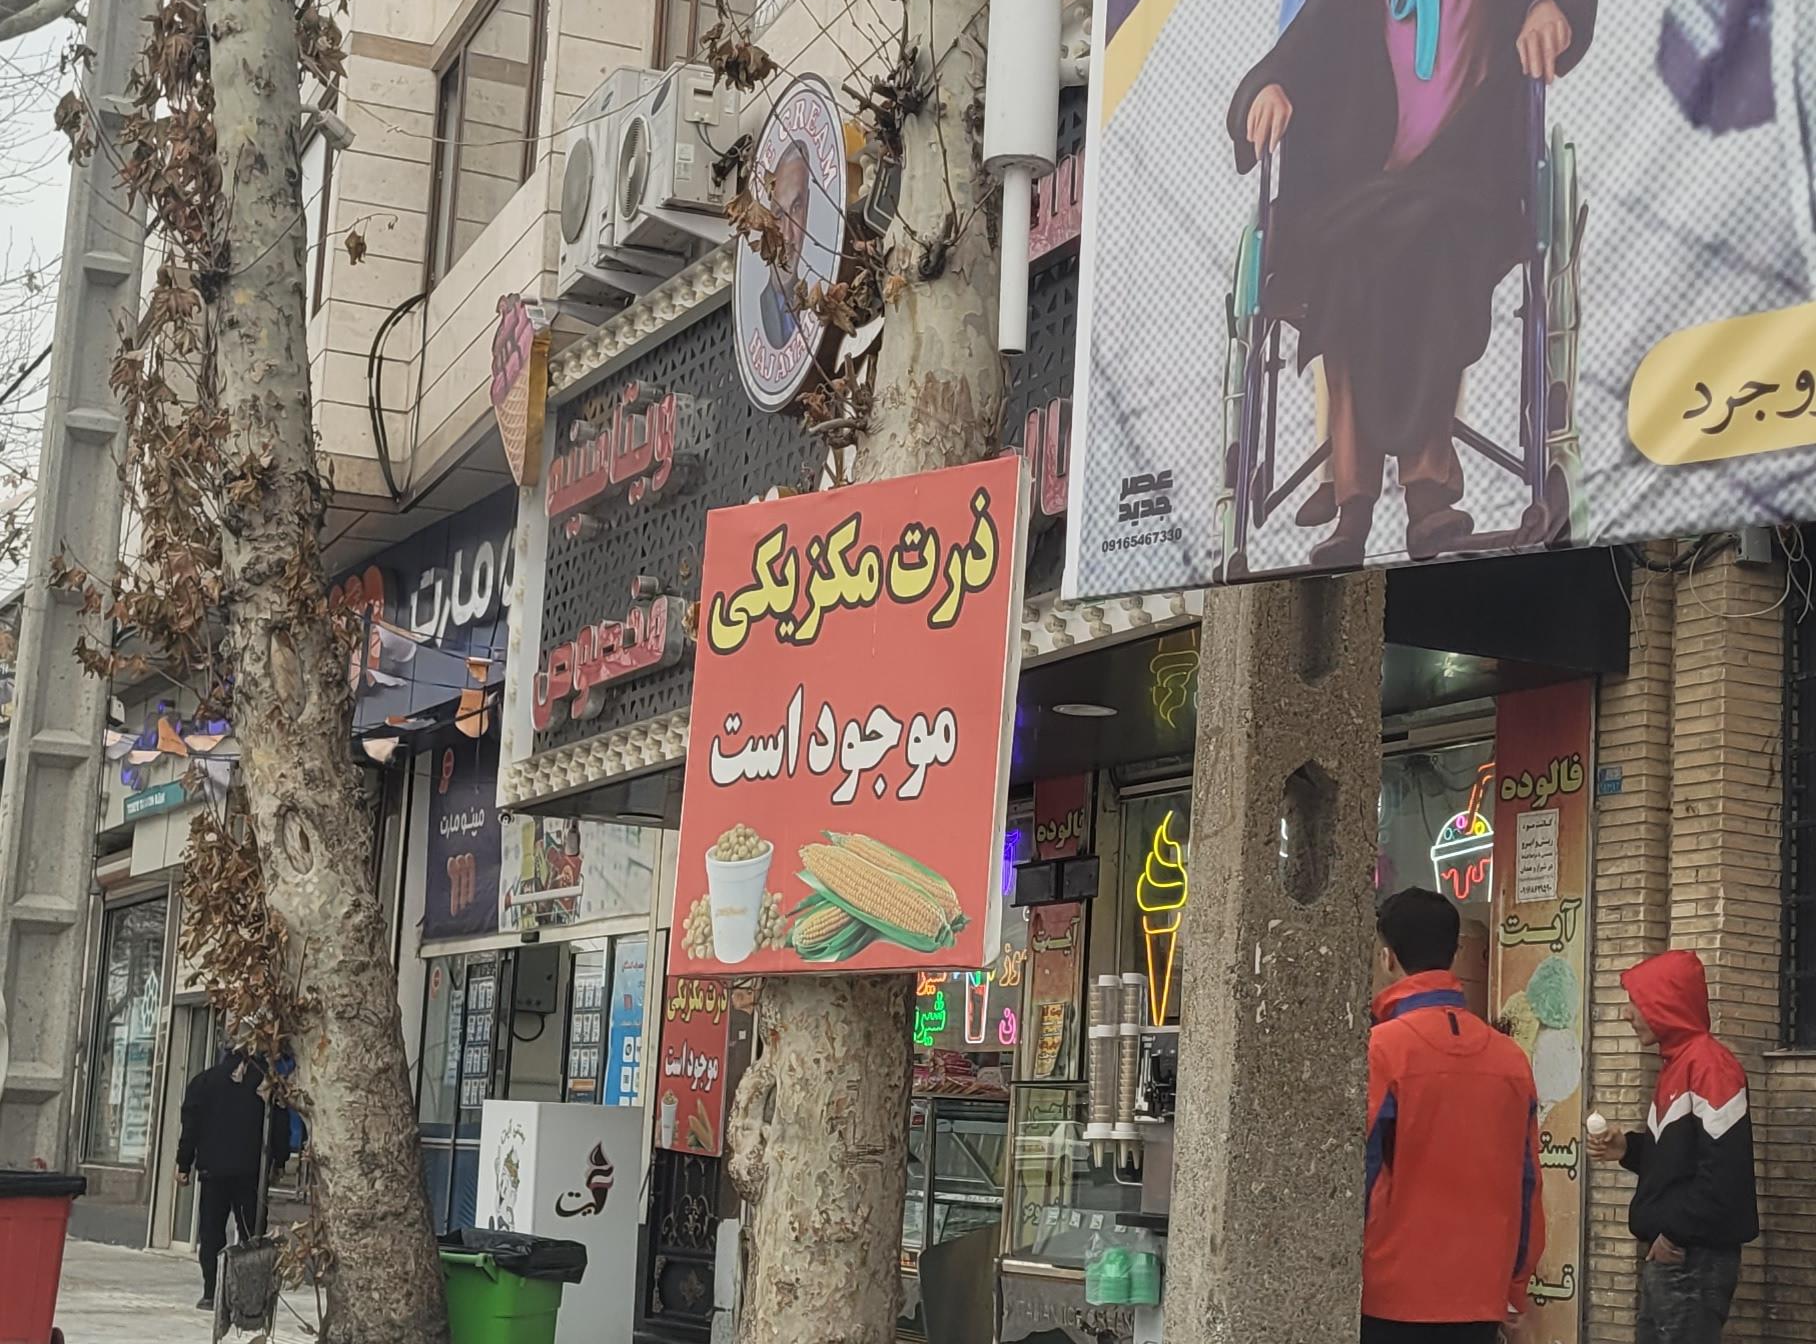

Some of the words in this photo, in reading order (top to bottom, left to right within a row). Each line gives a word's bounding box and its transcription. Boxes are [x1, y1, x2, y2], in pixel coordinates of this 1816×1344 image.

[779, 98, 838, 192] CREAM
[1682, 369, 1816, 435] وجرد
[1118, 494, 1173, 527] جدید
[1119, 468, 1174, 502] عصر
[888, 487, 999, 630] ذرت
[1101, 527, 1183, 553] 09165467330
[708, 512, 883, 654] مکزیکی
[709, 683, 805, 787] است
[808, 700, 957, 805] موجود
[1500, 752, 1584, 809] فالوده
[1498, 898, 1582, 953] آیت
[666, 977, 705, 1023] مکزیکی
[664, 1040, 688, 1078] است
[686, 1049, 719, 1092] موجود
[1537, 1131, 1579, 1181] بست
